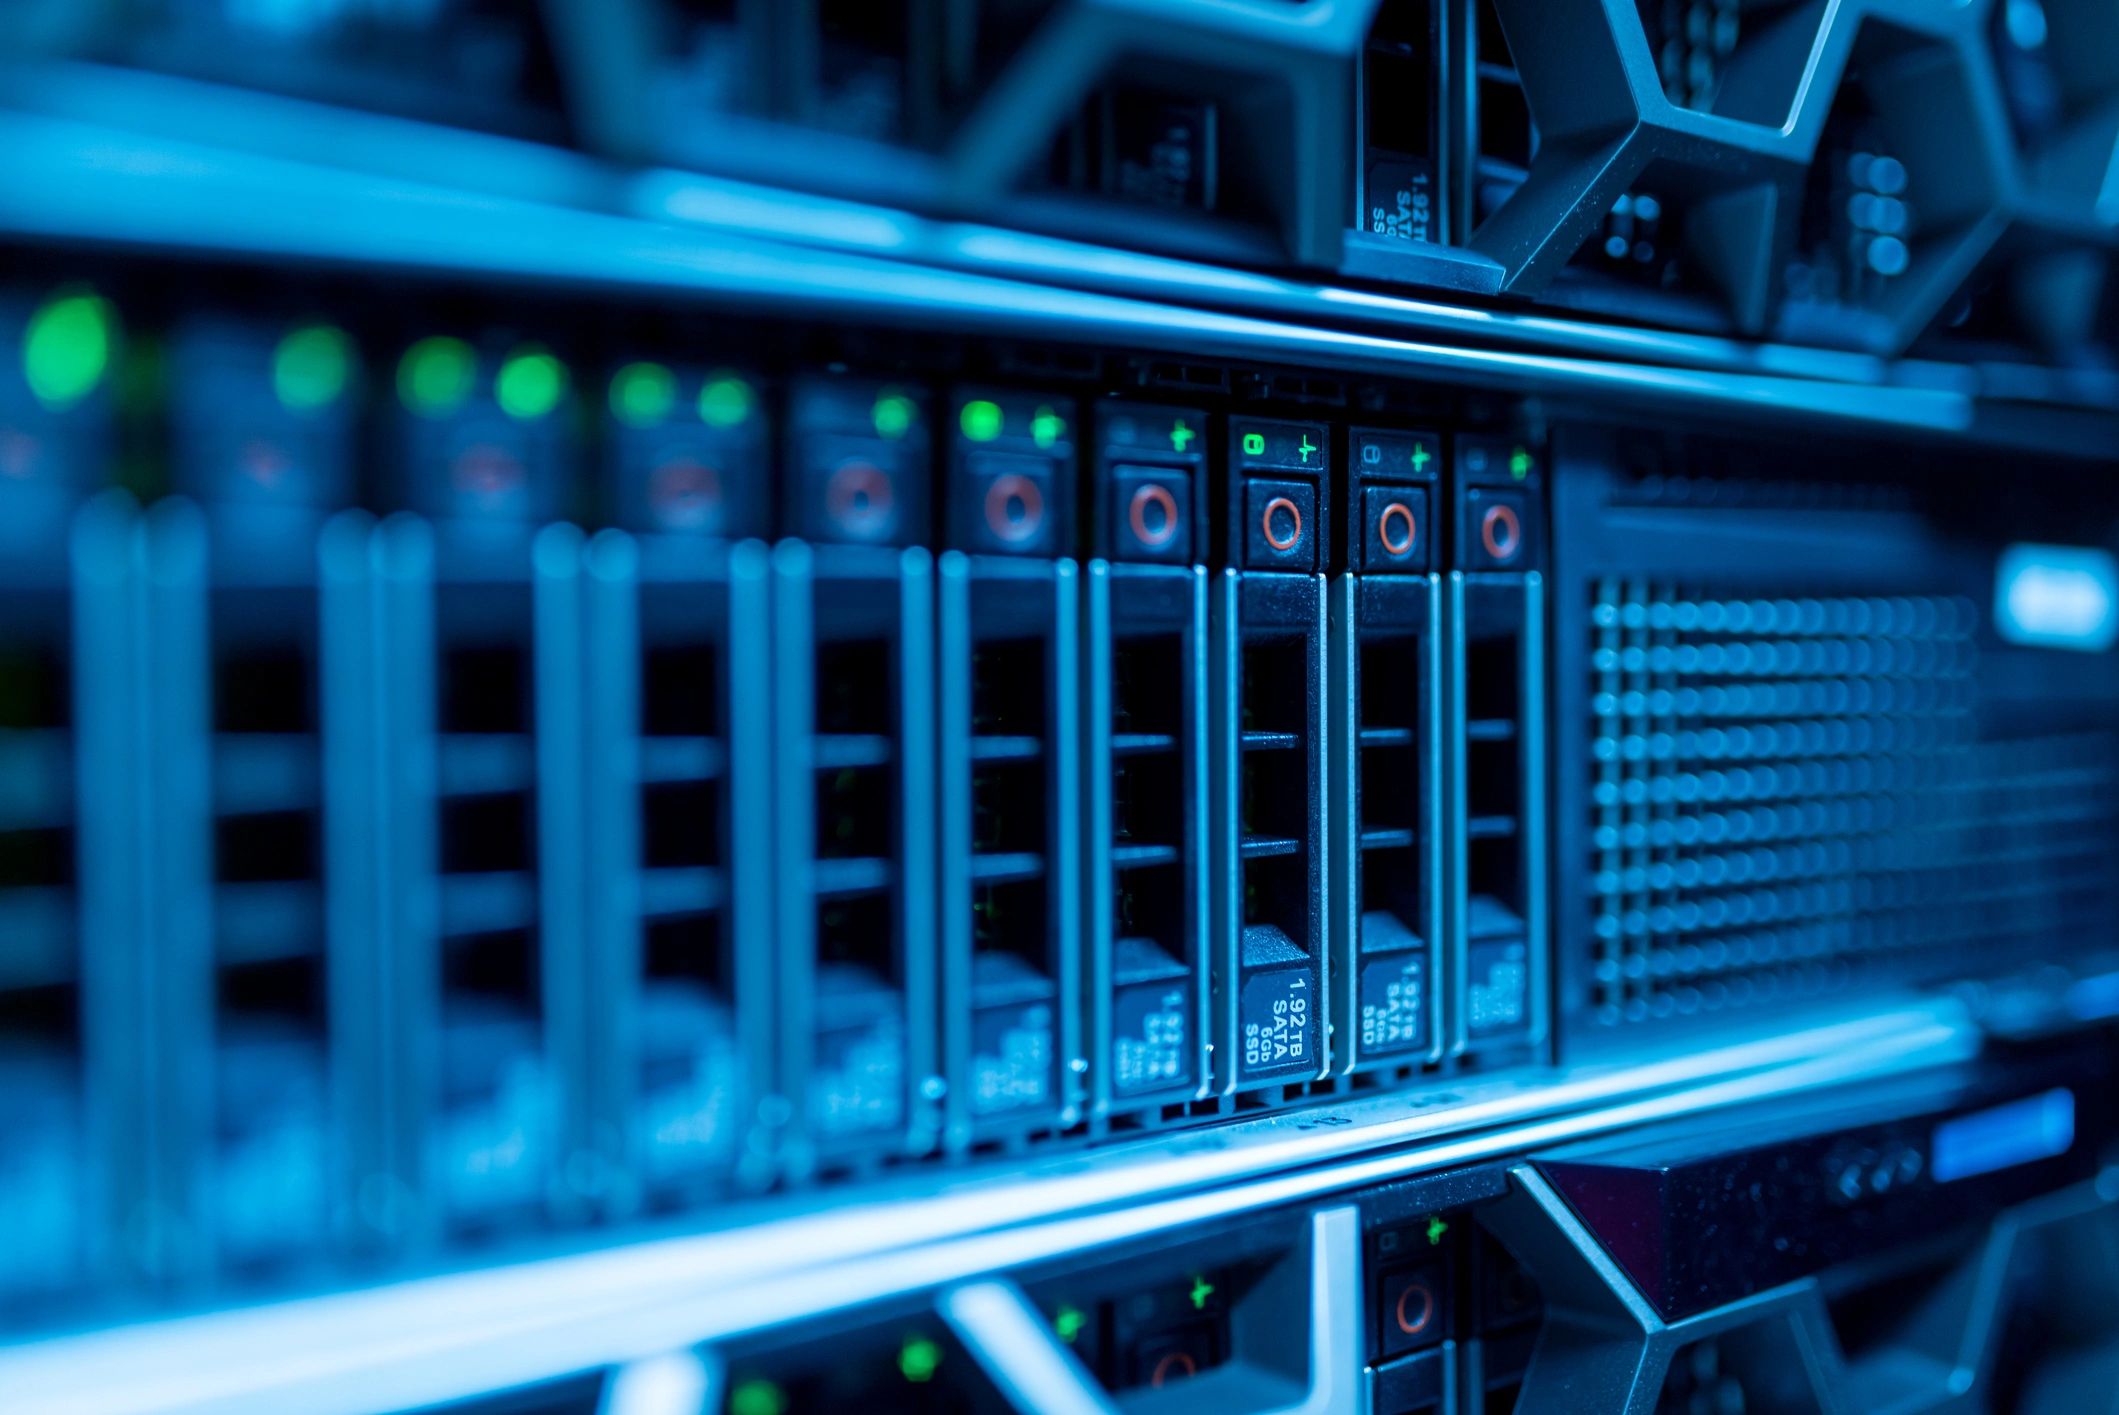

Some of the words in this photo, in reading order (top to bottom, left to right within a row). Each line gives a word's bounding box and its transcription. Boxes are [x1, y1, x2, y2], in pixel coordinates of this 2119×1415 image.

[1373, 207, 1385, 234] SS
[1273, 1000, 1287, 1059] SATA
[1290, 978, 1306, 1057] 1.92TB
[1362, 1005, 1375, 1045] SSD
[1387, 982, 1401, 1042] SATA
[1246, 1023, 1259, 1064] SSD
[1261, 1026, 1273, 1062] 6Gb
